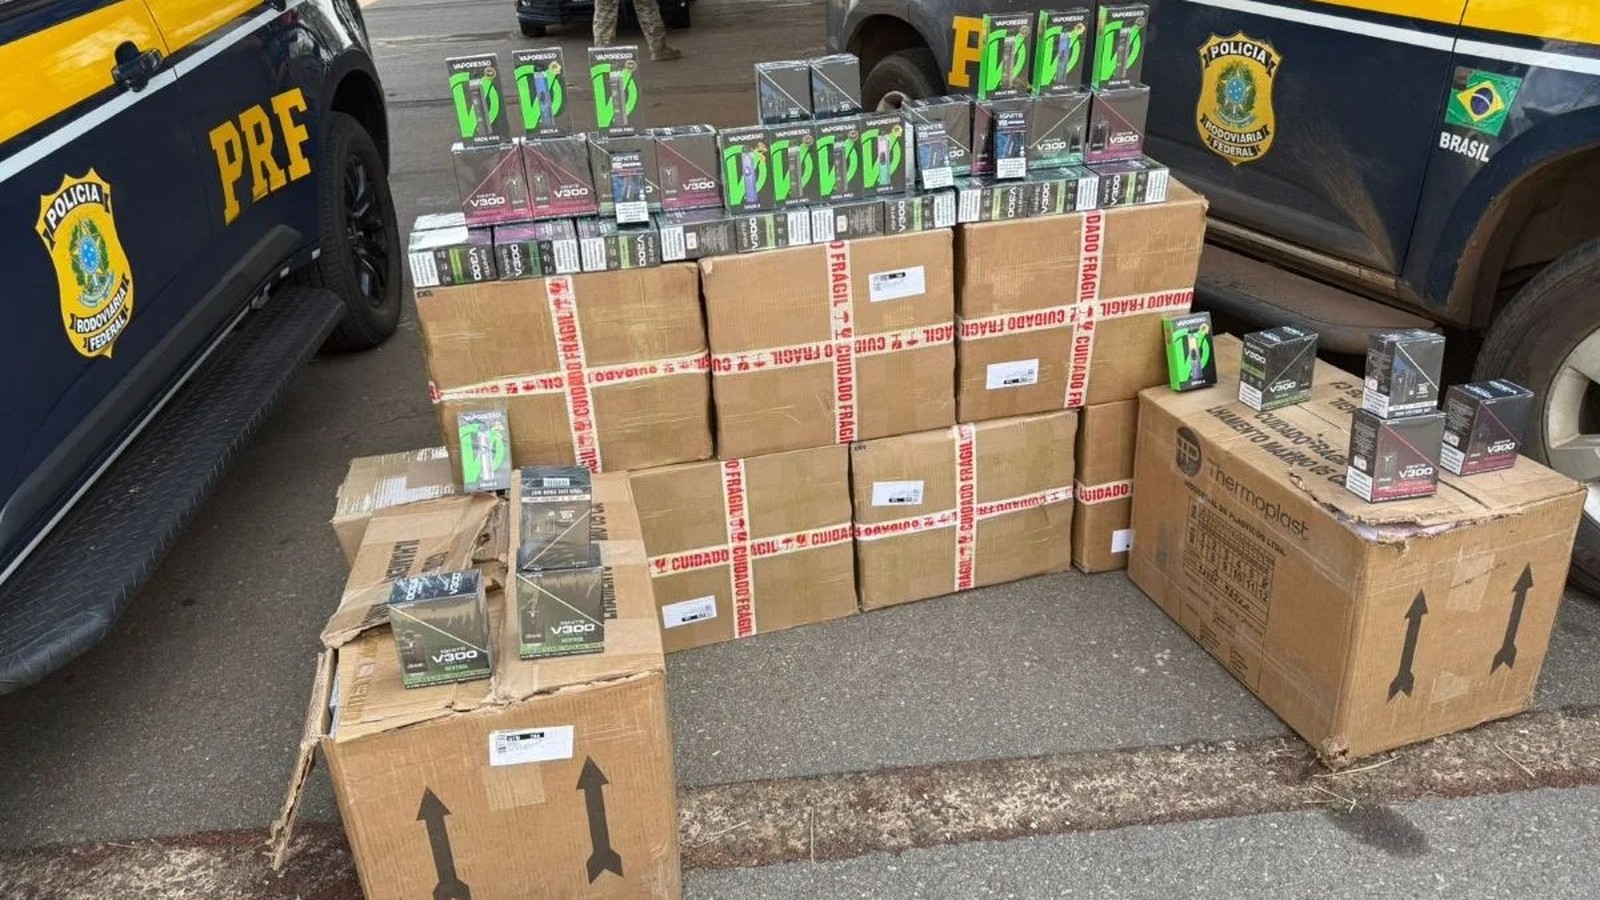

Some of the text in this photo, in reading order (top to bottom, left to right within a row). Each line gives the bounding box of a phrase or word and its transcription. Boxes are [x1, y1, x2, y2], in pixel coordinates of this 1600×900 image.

[1037, 141, 1067, 151] V300
[1109, 134, 1139, 145] V300
[1211, 139, 1254, 156] FEDERAL
[1438, 131, 1491, 164] BRASIL
[208, 88, 311, 226] PRF
[553, 187, 589, 198] V300
[682, 181, 716, 191] V300
[470, 196, 507, 208] V300
[1147, 291, 1196, 309] UIDADO
[1008, 309, 1065, 331] CUIDADO
[89, 313, 127, 351] FEDERAL
[1069, 335, 1091, 389] CUIDADO
[836, 343, 853, 402] CUIDADO
[1269, 381, 1296, 393] V300
[1398, 466, 1433, 478] V300
[960, 484, 974, 531] CUIDADO
[1206, 457, 1310, 541] Thermoplast
[671, 549, 730, 572] CUIDADO
[733, 546, 749, 596] CUIDADO
[550, 623, 596, 635] V300
[431, 650, 479, 664] V300
